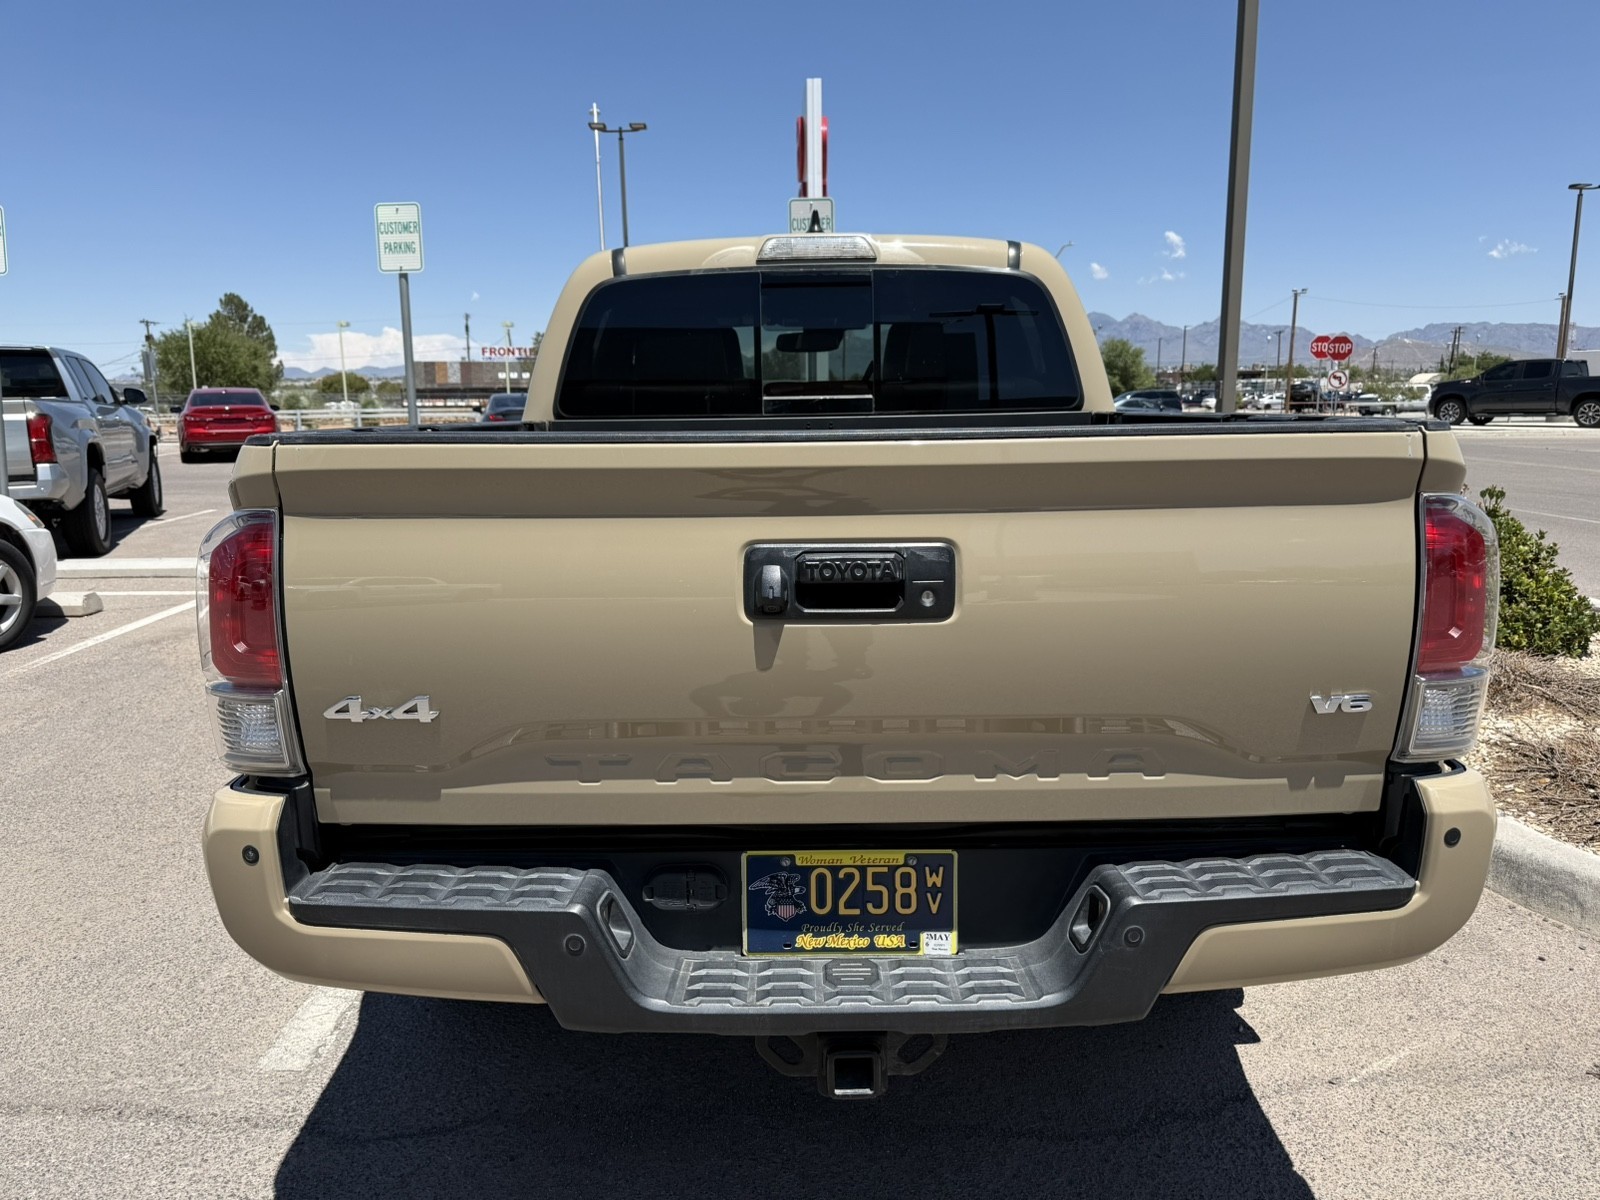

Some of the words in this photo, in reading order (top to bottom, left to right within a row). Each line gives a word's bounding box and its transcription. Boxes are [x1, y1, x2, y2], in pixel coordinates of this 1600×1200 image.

[379, 221, 419, 235] CUSTOMER
[791, 217, 832, 231] CUSTER
[383, 241, 416, 255] PARKING
[1311, 342, 1328, 353] STO
[1328, 343, 1352, 354] STOP
[804, 560, 897, 582] TOYOTA
[1309, 694, 1373, 714] V6
[544, 751, 1167, 786] TACOMA
[797, 855, 844, 865] Woman
[849, 854, 901, 865] Veteran
[810, 866, 918, 915] 0258
[801, 922, 843, 934] Proudly
[846, 922, 865, 933] She
[869, 922, 904, 933] Served
[796, 934, 826, 948] New
[826, 934, 871, 949] Mexico
[874, 934, 906, 948] USA
[929, 933, 950, 941] MAY
